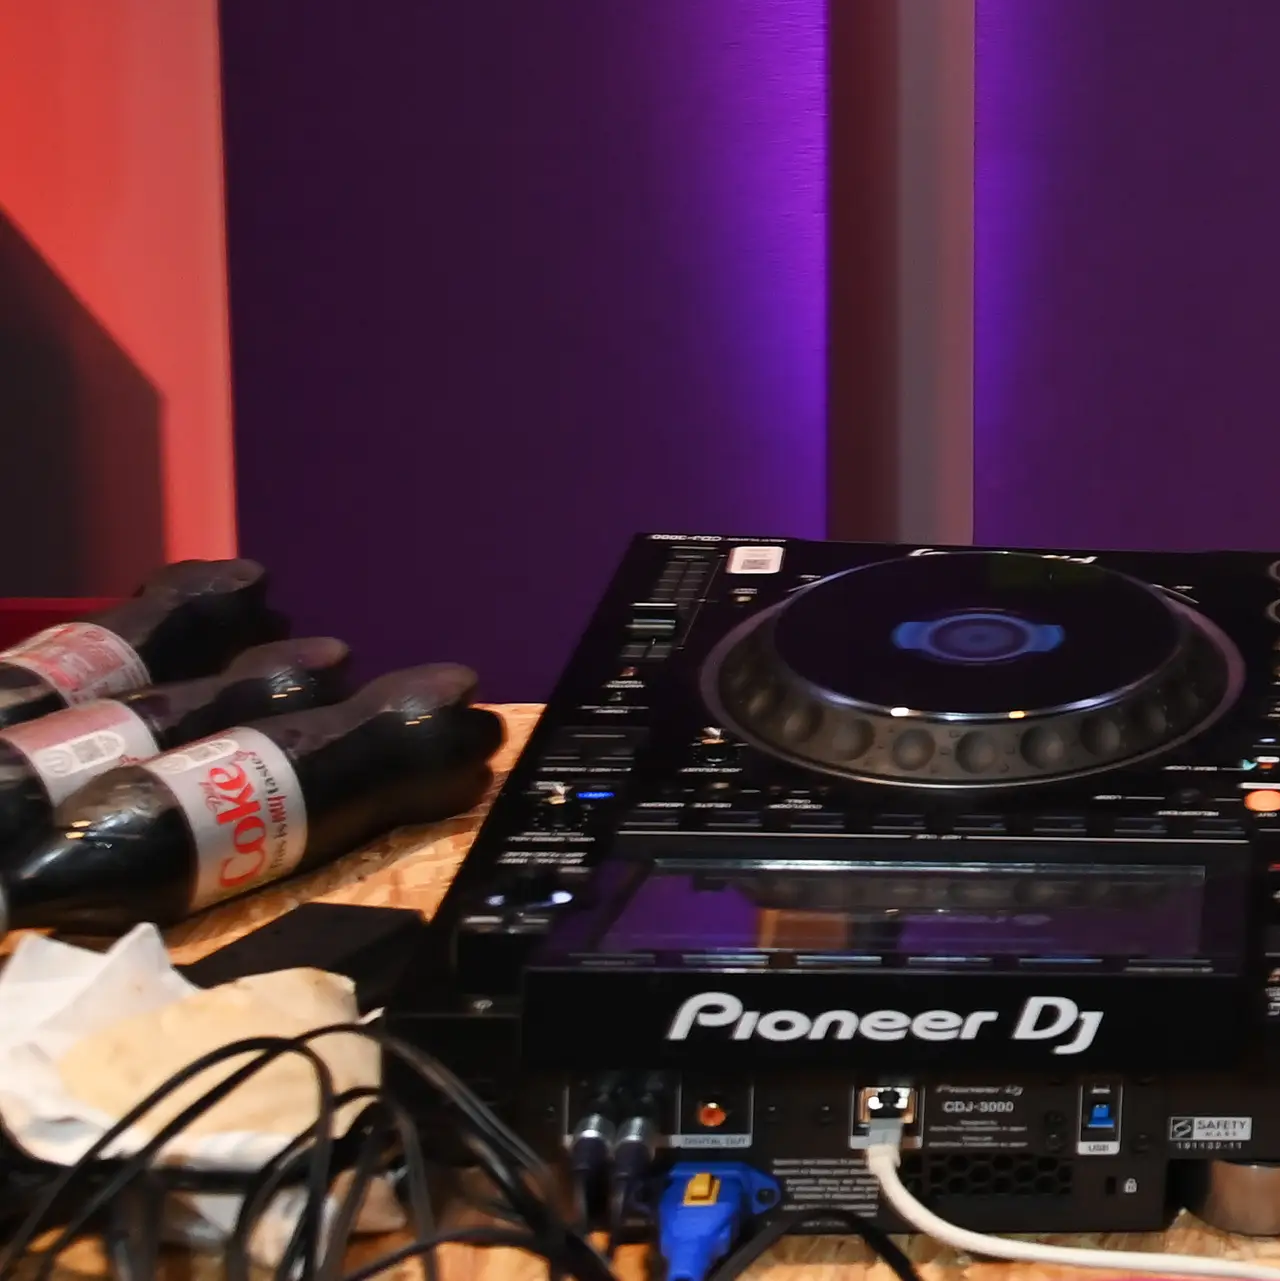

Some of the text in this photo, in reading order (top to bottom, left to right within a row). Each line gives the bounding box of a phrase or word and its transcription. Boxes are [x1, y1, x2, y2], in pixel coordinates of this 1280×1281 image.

[208, 761, 267, 888] Coke
[666, 991, 998, 1043] Pioneer
[941, 1100, 1015, 1114] CDJ-3000
[1196, 1119, 1248, 1131] SAFETY
